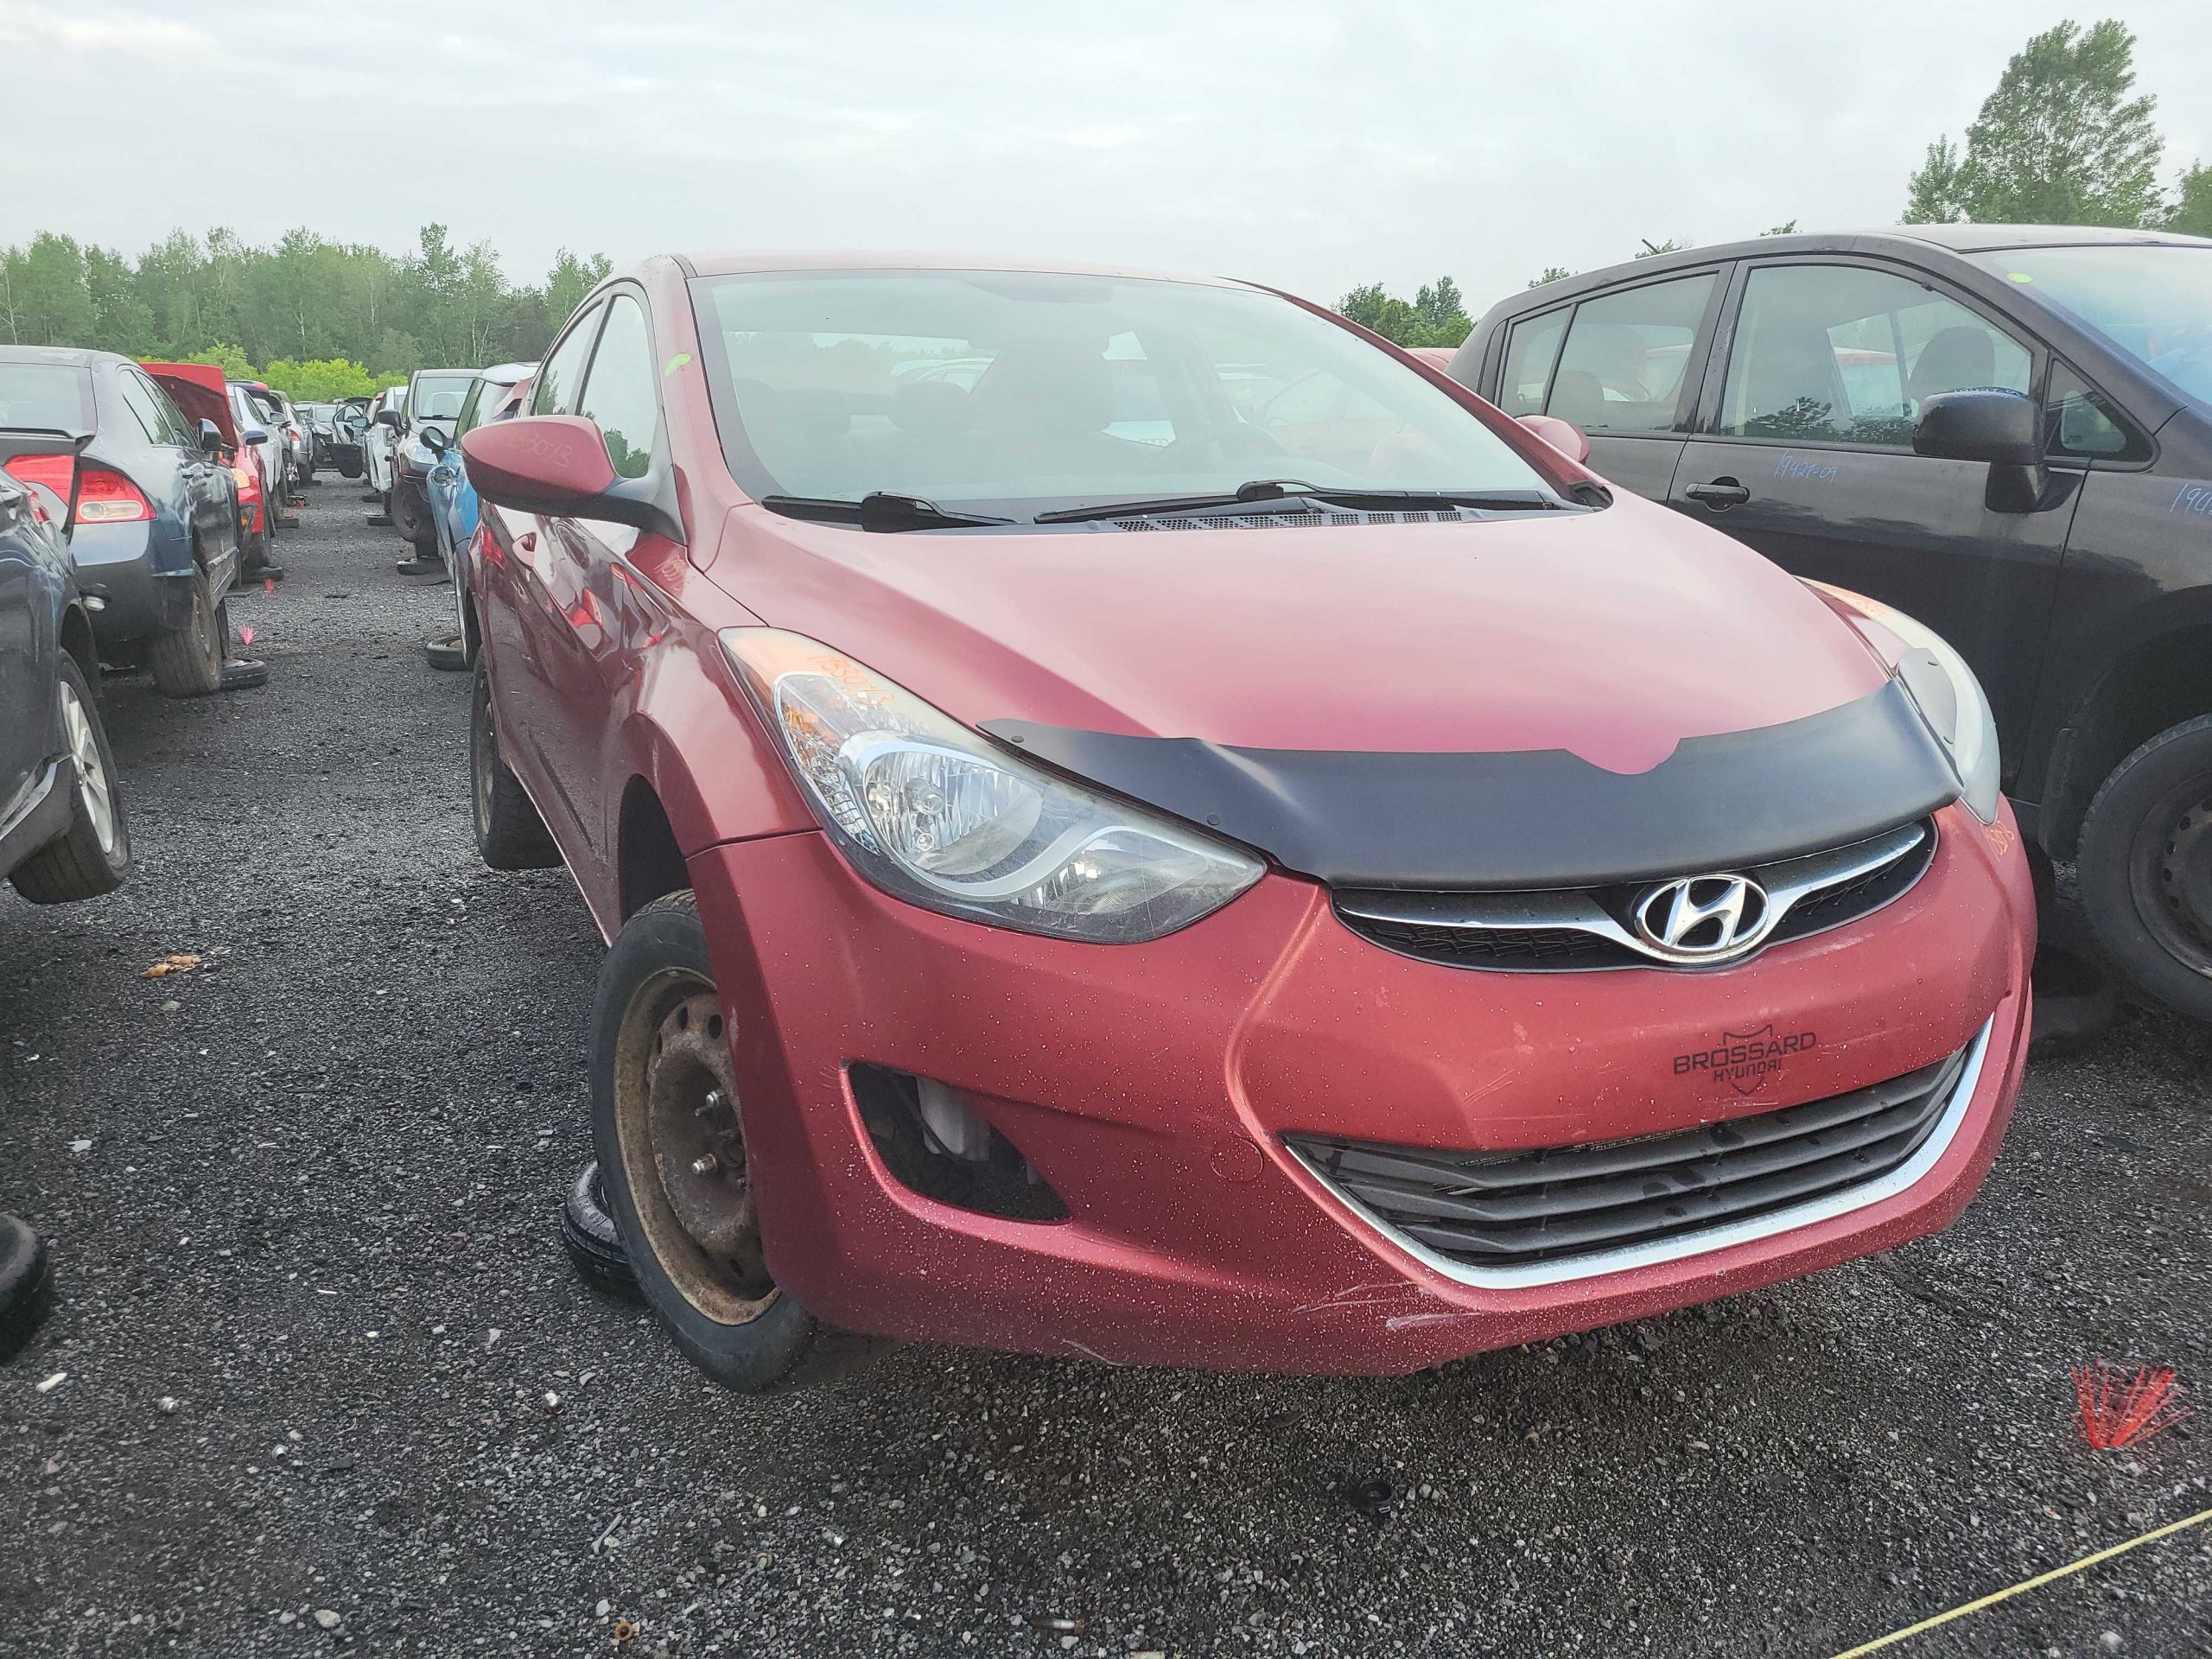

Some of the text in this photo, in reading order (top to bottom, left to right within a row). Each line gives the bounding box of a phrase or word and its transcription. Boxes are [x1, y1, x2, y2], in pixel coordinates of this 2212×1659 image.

[2170, 483, 2212, 516] 194
[1673, 1032, 1816, 1075] BROSSARD
[1713, 1058, 1782, 1083] HYUNDAI
